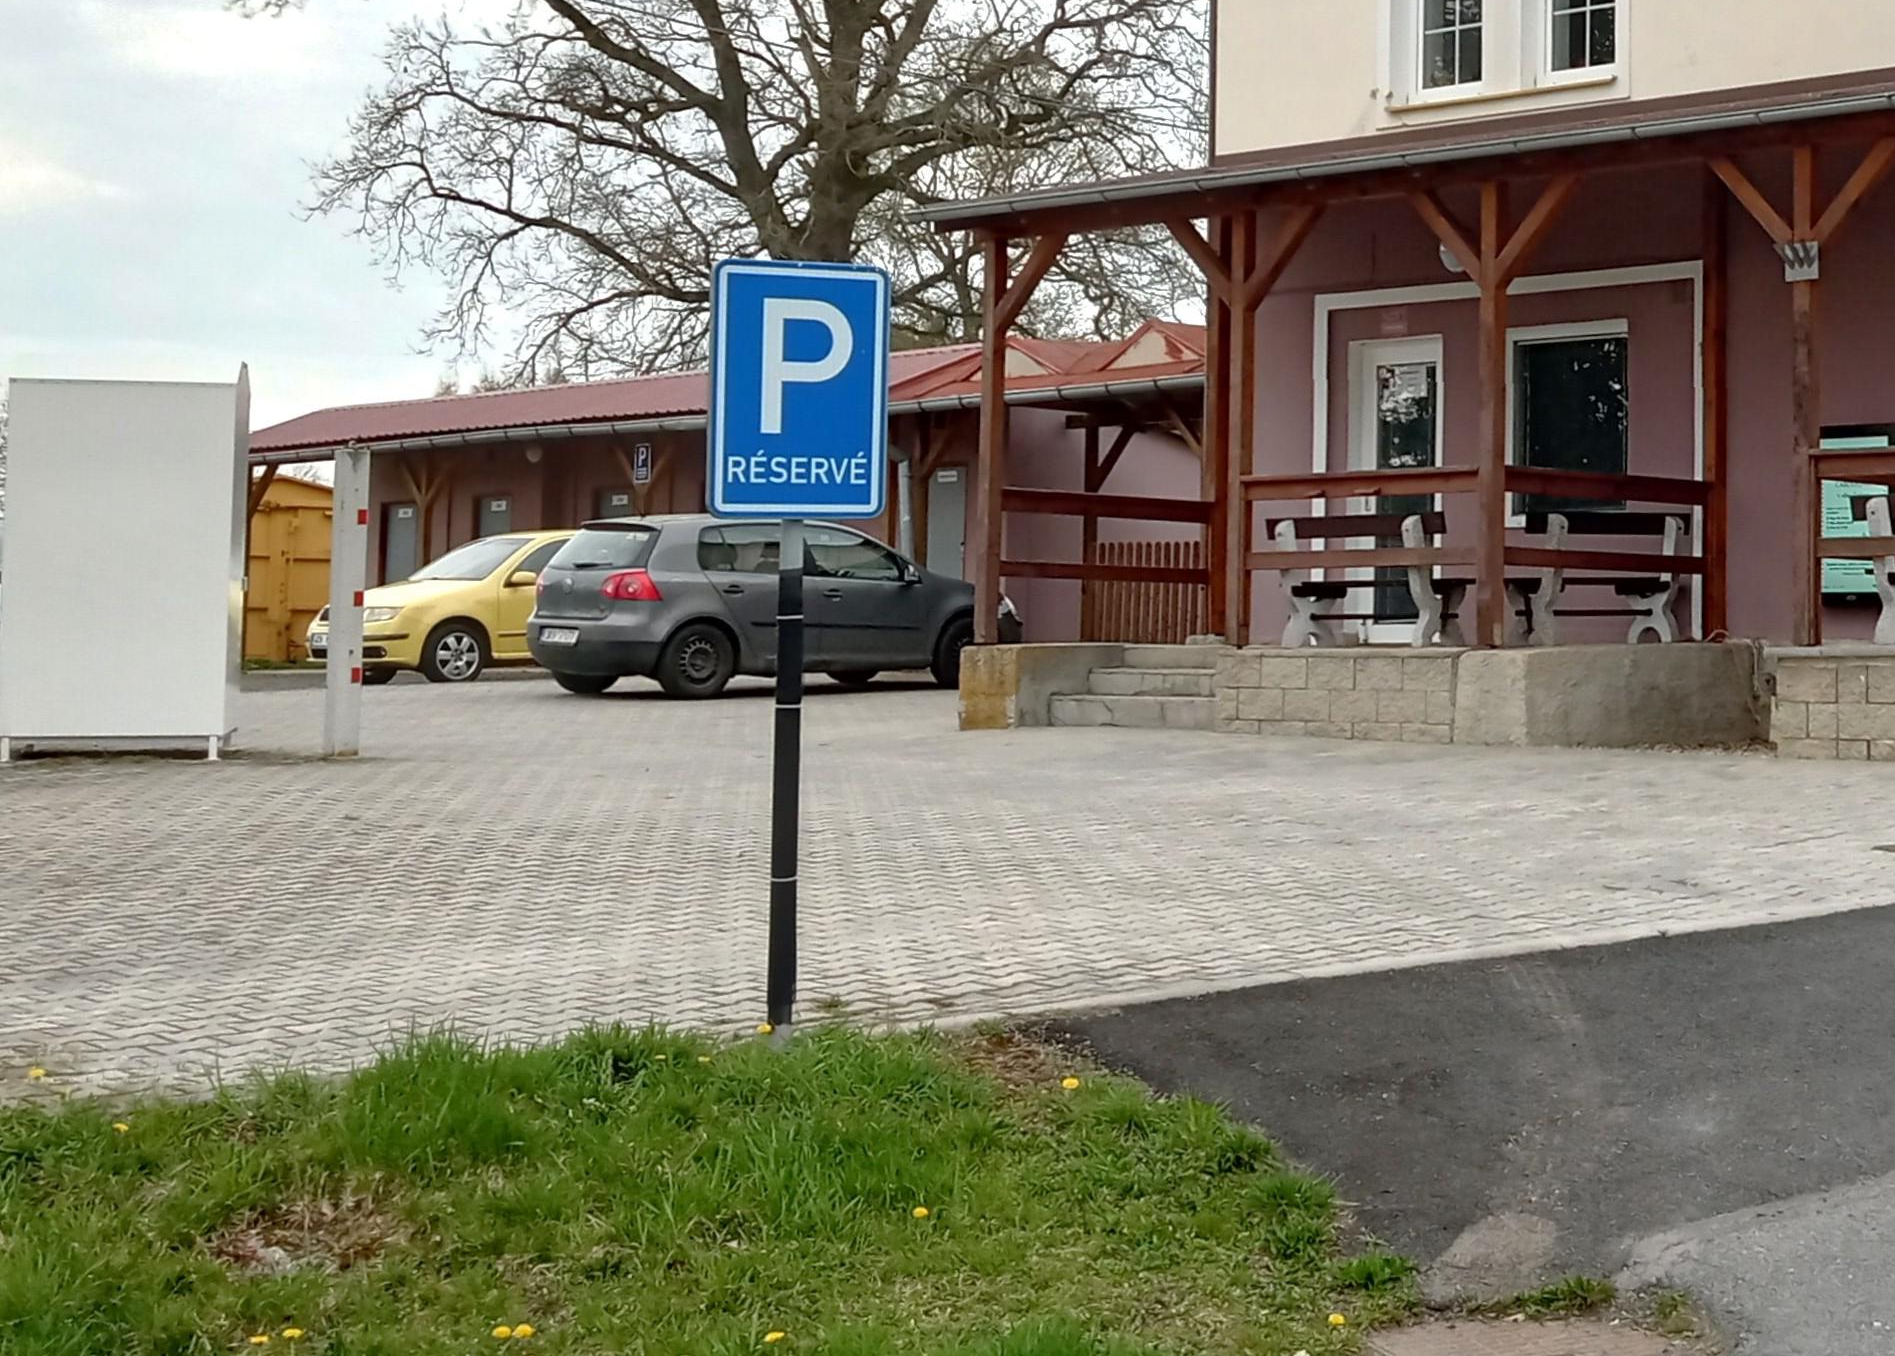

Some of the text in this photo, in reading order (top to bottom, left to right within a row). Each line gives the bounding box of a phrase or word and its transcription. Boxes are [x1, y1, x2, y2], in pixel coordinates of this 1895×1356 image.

[760, 297, 853, 434] P
[638, 447, 646, 467] P
[727, 449, 867, 484] RÉSERVÉ
